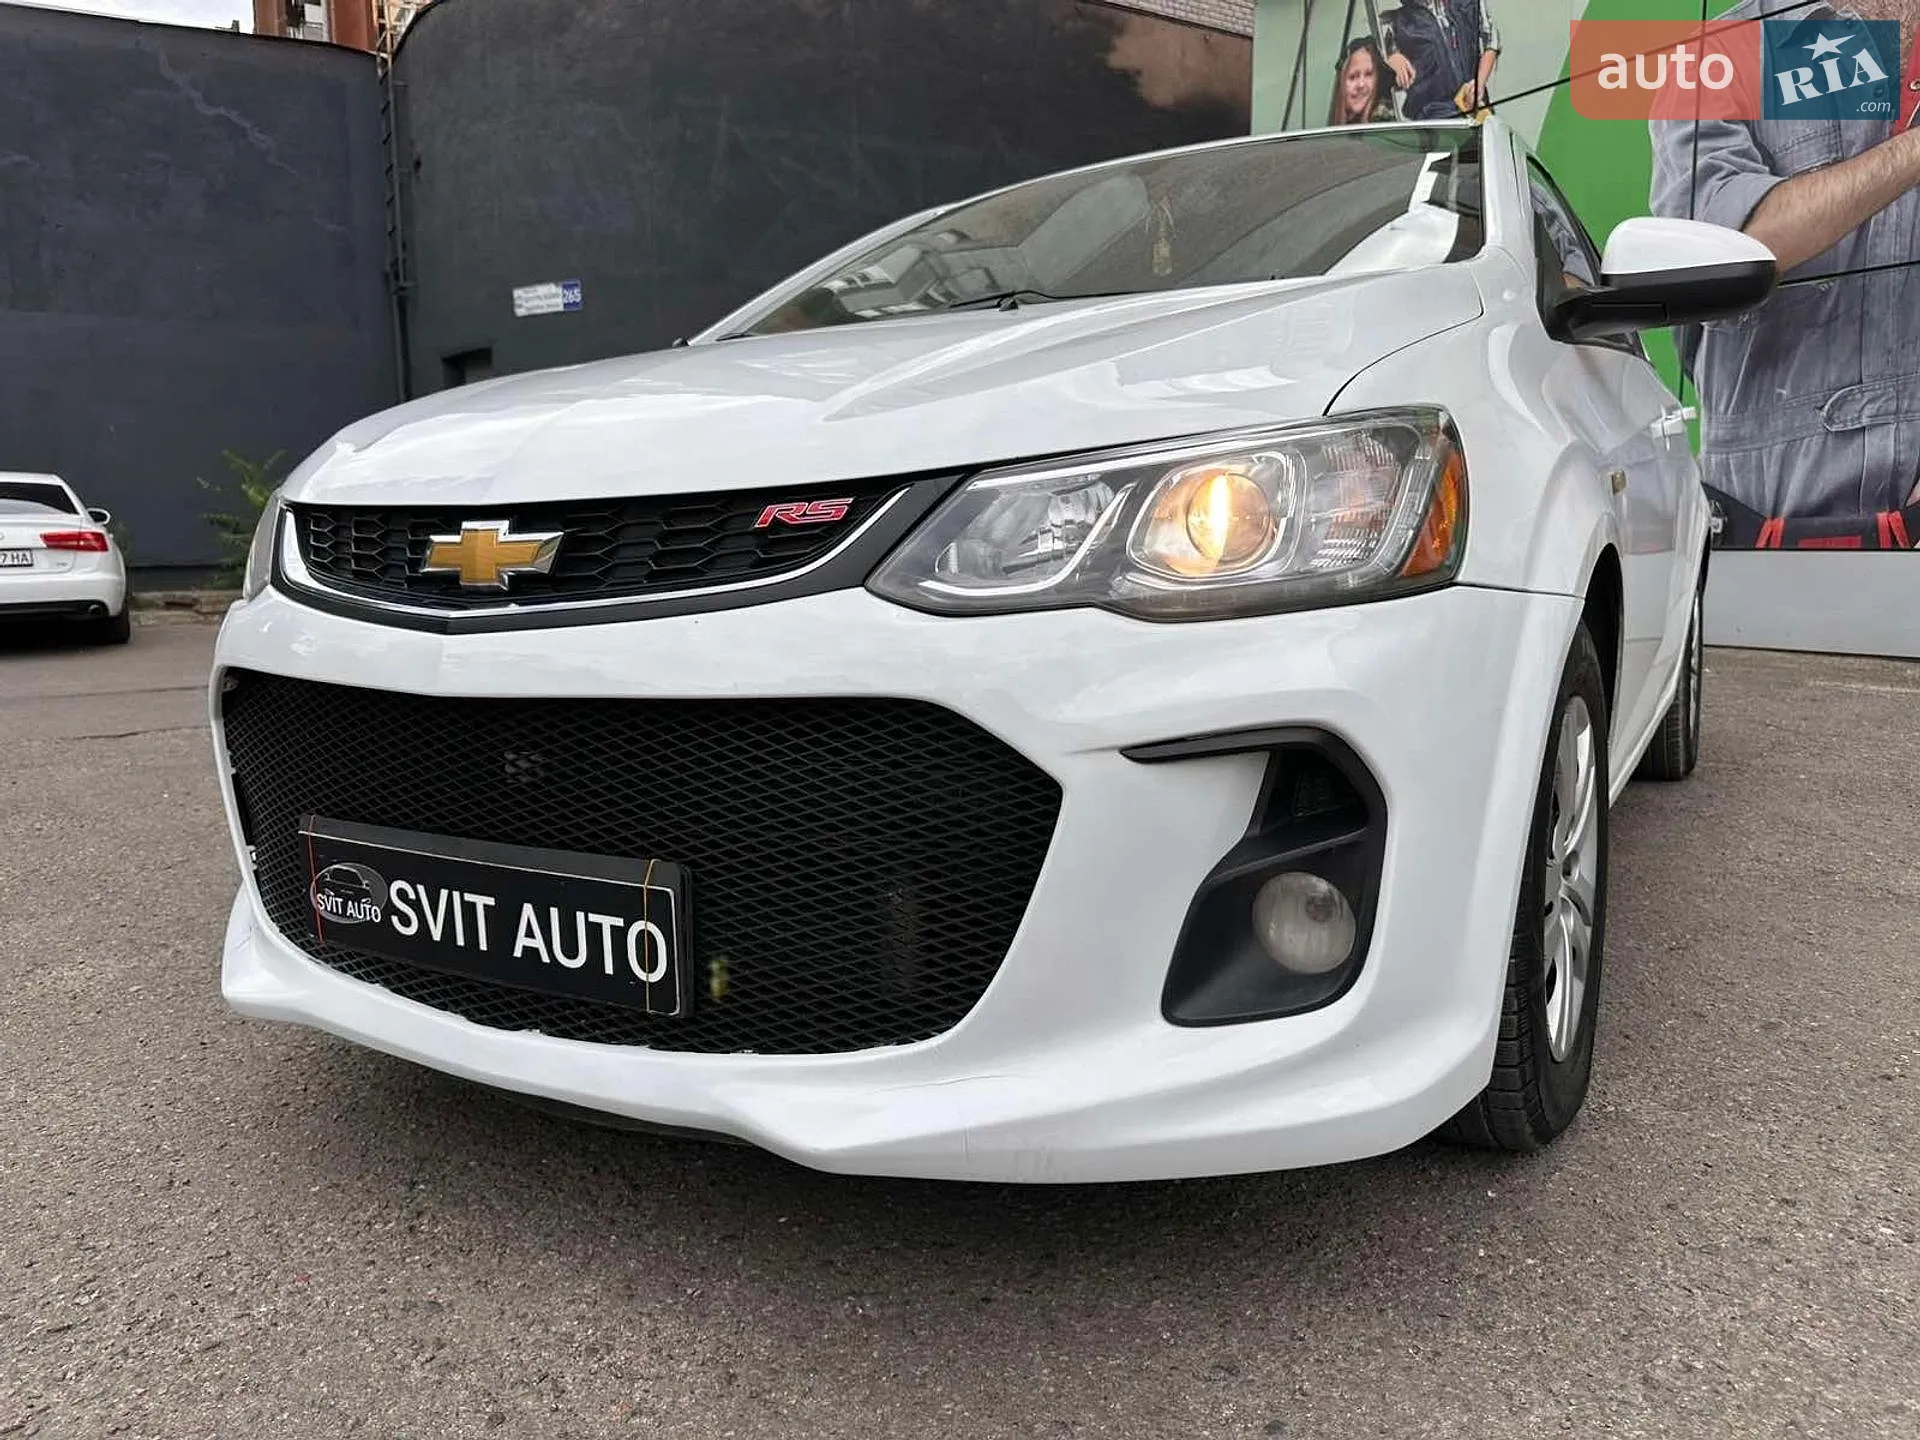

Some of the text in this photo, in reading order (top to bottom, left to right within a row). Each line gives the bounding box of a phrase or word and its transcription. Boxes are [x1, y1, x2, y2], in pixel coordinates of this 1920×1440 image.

[754, 497, 854, 527] RS
[11, 552, 29, 563] HA
[316, 893, 381, 923] SVIT AUTO
[389, 879, 667, 983] SVIT AUTO
